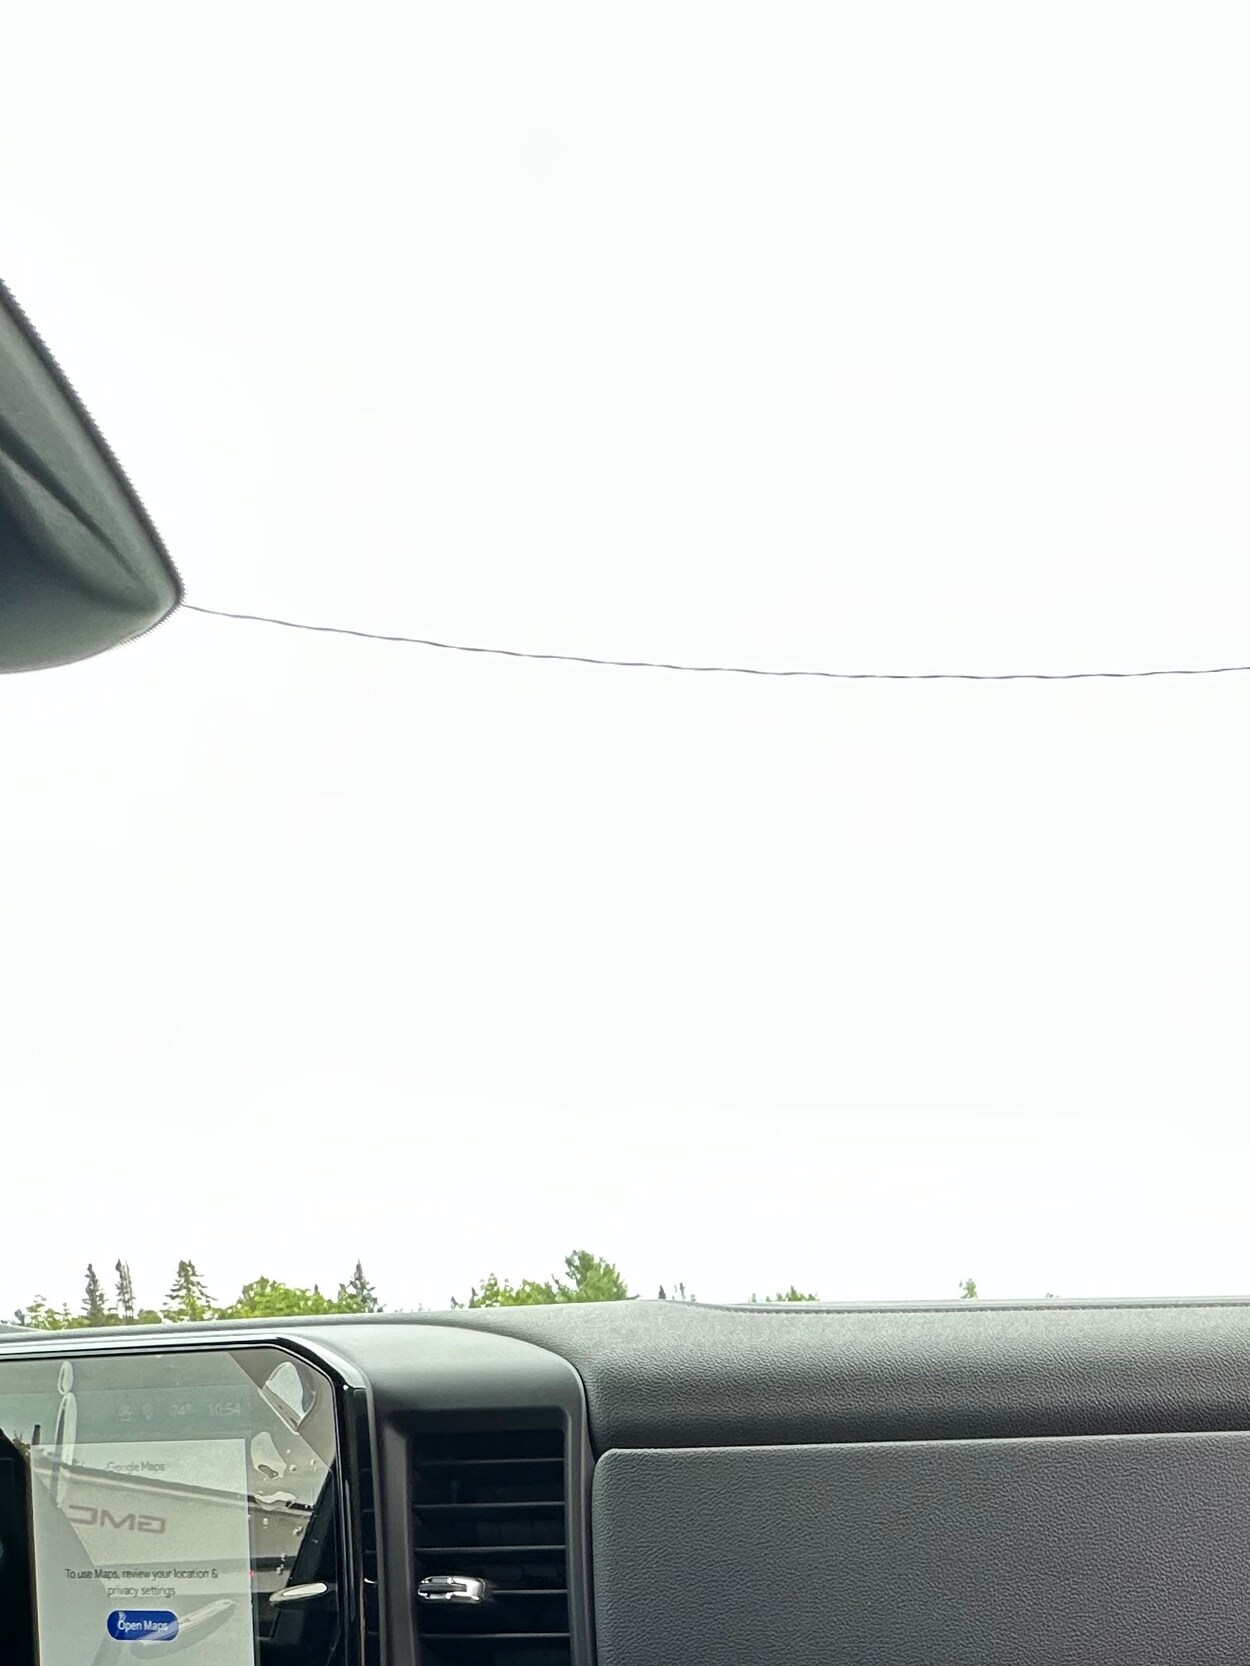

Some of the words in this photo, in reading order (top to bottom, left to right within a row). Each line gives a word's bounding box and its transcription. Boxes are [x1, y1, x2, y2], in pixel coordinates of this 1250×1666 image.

[107, 1461, 139, 1475] Google
[141, 1461, 166, 1473] Maps
[65, 1568, 75, 1579] To
[77, 1571, 93, 1579] use
[122, 1569, 150, 1579] review
[152, 1571, 172, 1581] your
[173, 1568, 209, 1579] location
[211, 1568, 218, 1579] &
[107, 1586, 138, 1598] privacy
[141, 1585, 176, 1598] settings
[118, 1619, 142, 1633] Open
[143, 1619, 169, 1632] Maps
